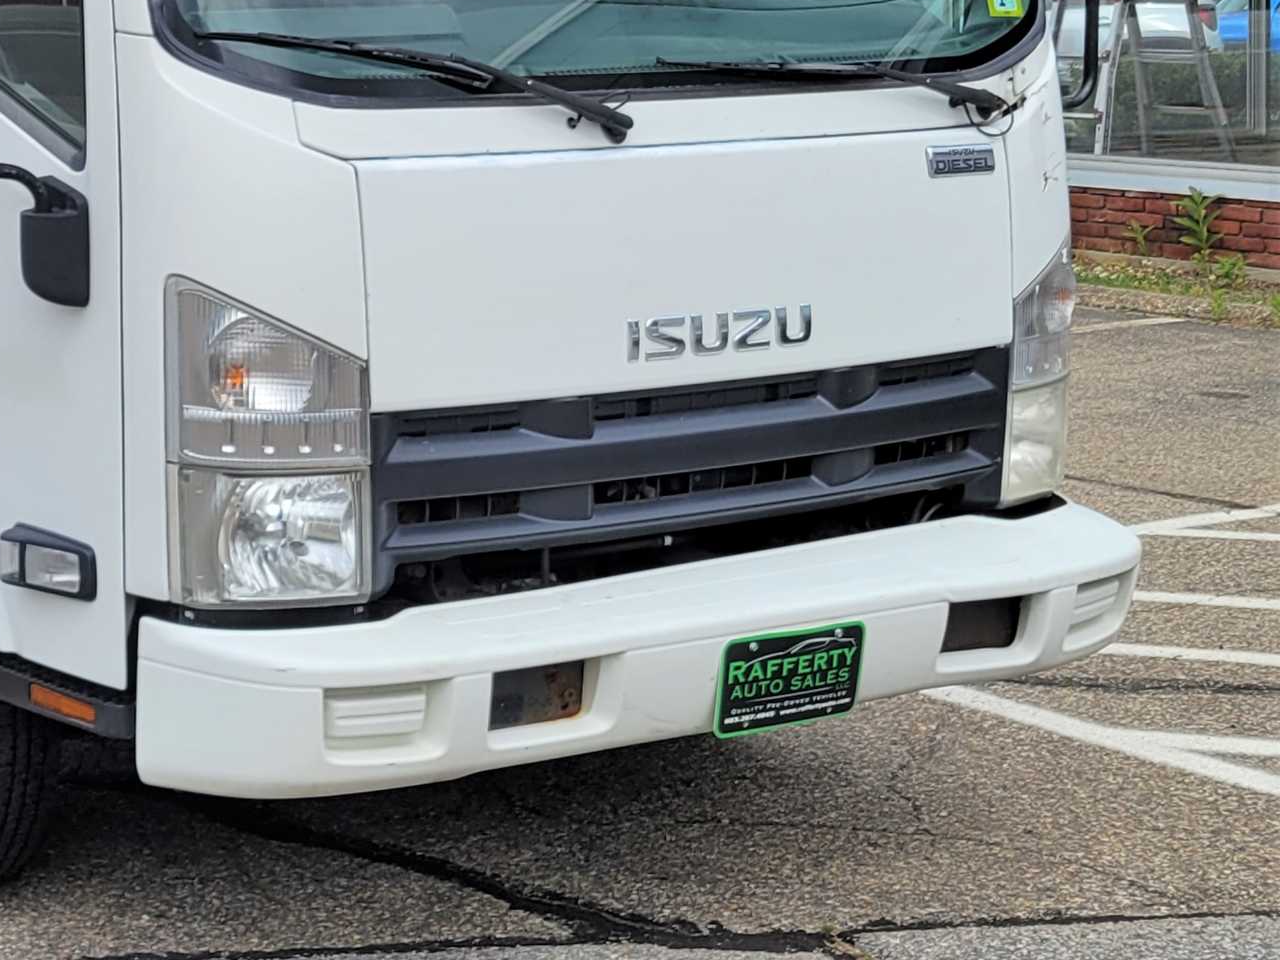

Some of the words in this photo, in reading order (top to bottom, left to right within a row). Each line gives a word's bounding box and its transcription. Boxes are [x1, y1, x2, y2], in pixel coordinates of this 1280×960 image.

[935, 156, 993, 172] DIESEL
[627, 303, 811, 363] ISUZU
[728, 647, 857, 685] RAFFERTY
[730, 679, 784, 700] AUTO
[790, 667, 850, 691] SALES
